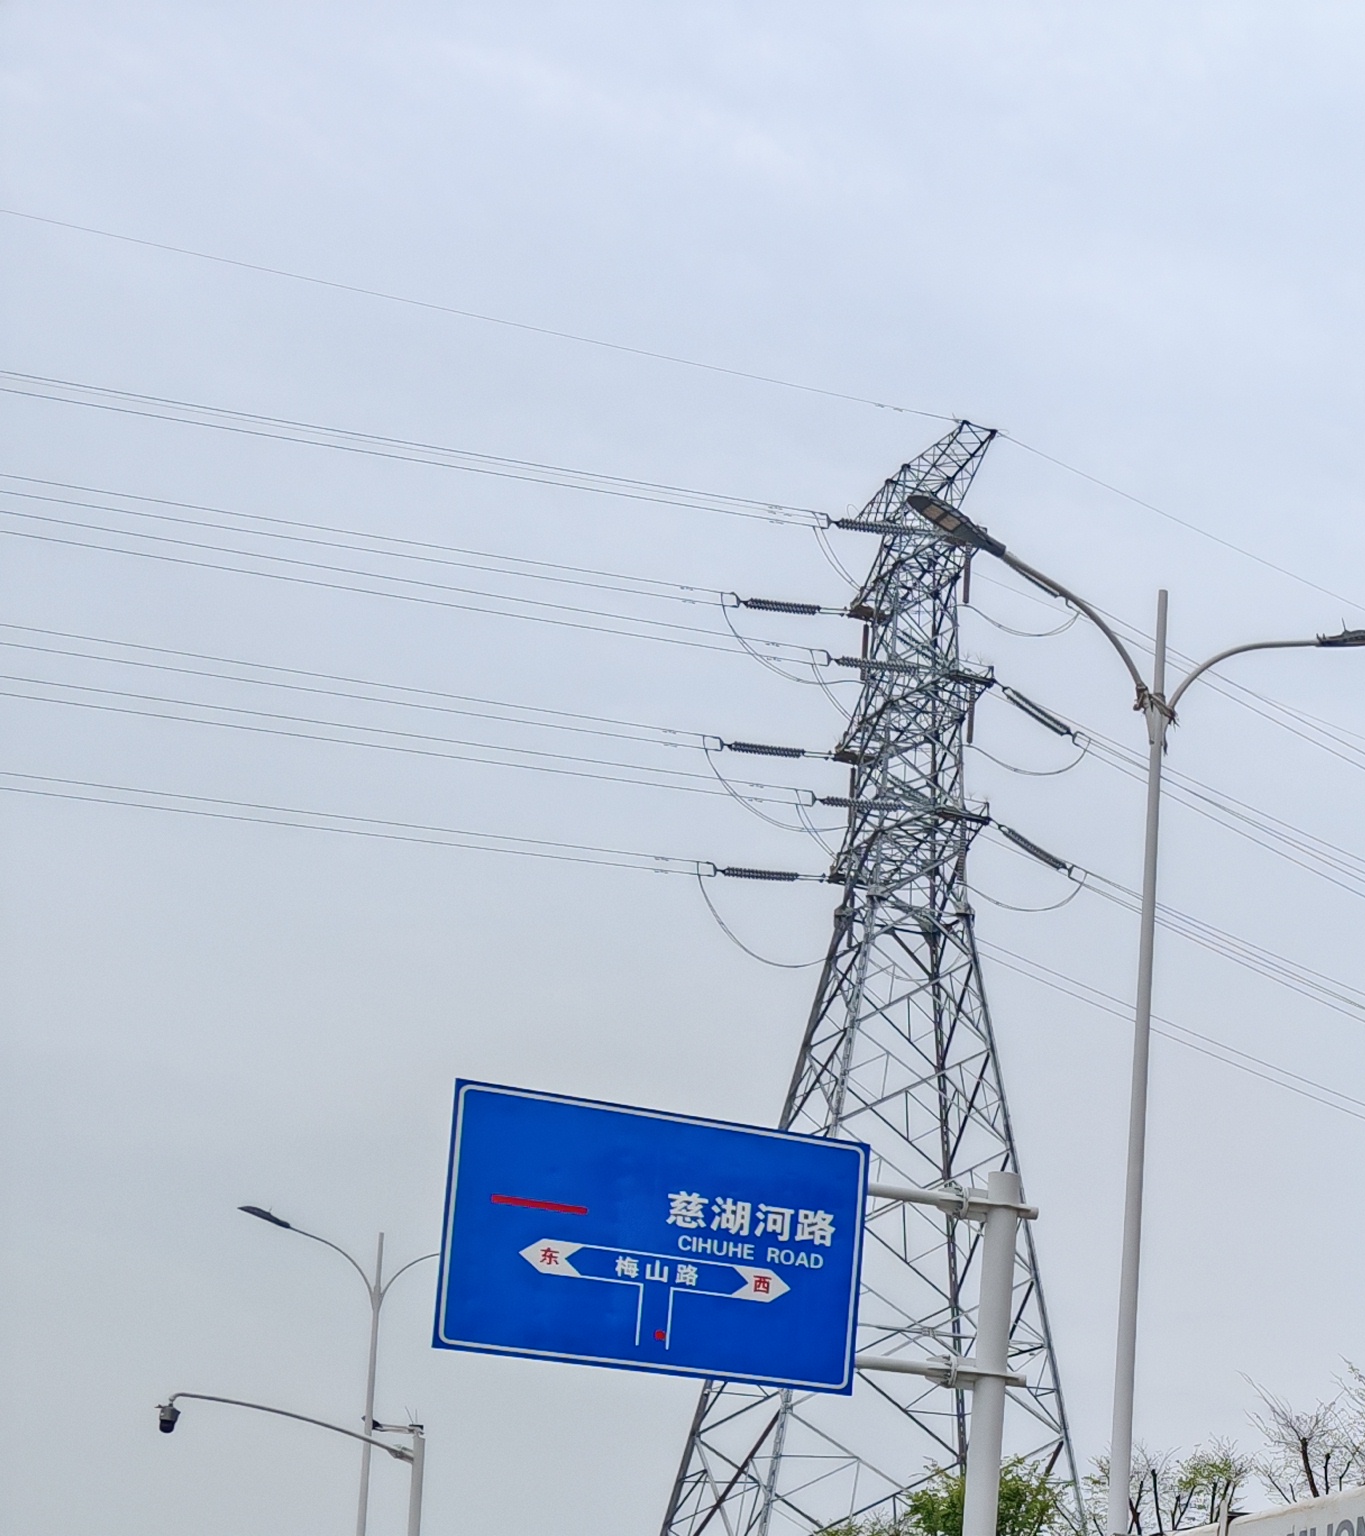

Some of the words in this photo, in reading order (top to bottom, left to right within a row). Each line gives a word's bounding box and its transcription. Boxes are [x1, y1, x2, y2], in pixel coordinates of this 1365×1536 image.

[666, 1190, 836, 1247] 慈湖河路
[539, 1247, 560, 1266] 东
[677, 1234, 755, 1261] CIHUHE
[766, 1246, 824, 1269] ROAD
[615, 1255, 699, 1287] 梅山路
[753, 1275, 772, 1294] 西
